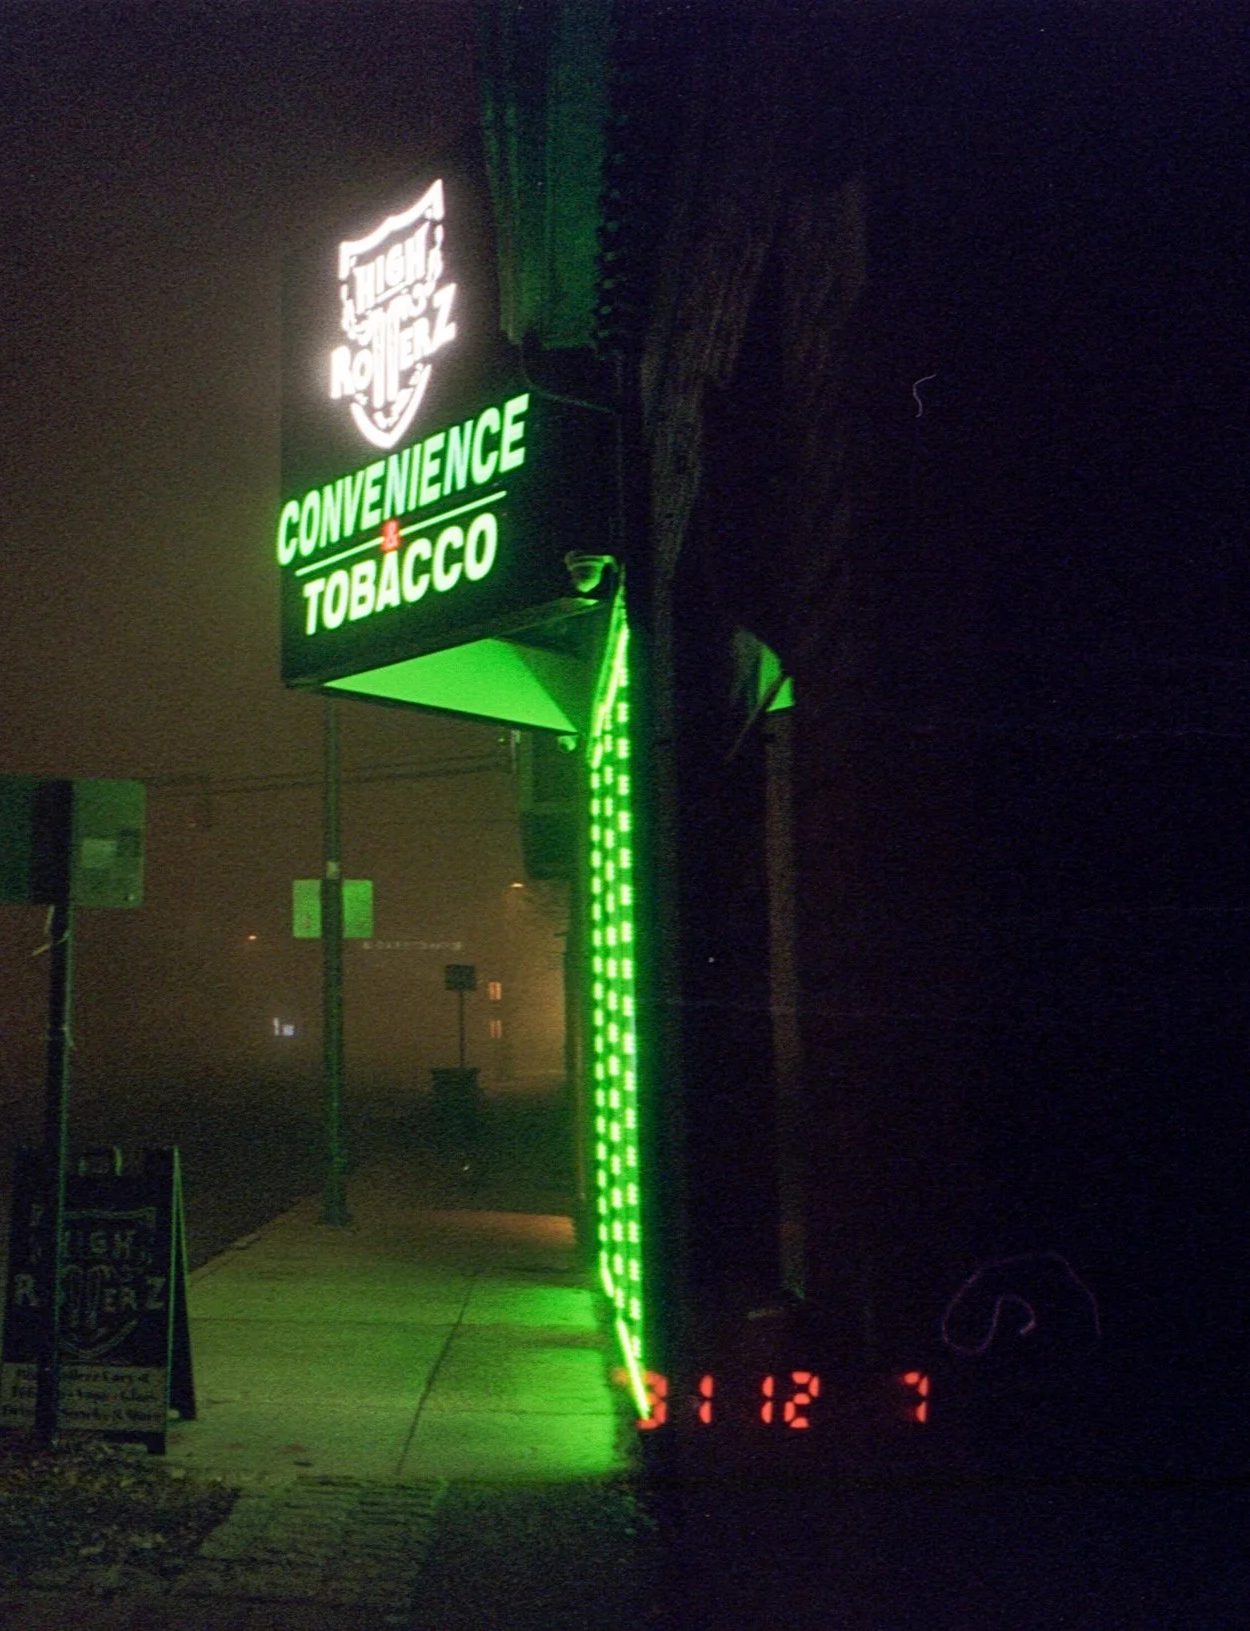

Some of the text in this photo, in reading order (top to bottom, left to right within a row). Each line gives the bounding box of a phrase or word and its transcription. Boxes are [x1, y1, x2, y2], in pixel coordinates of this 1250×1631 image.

[353, 222, 430, 314] HIGH
[277, 393, 530, 567] CONVENIENCE
[302, 512, 498, 637] TOBACCO
